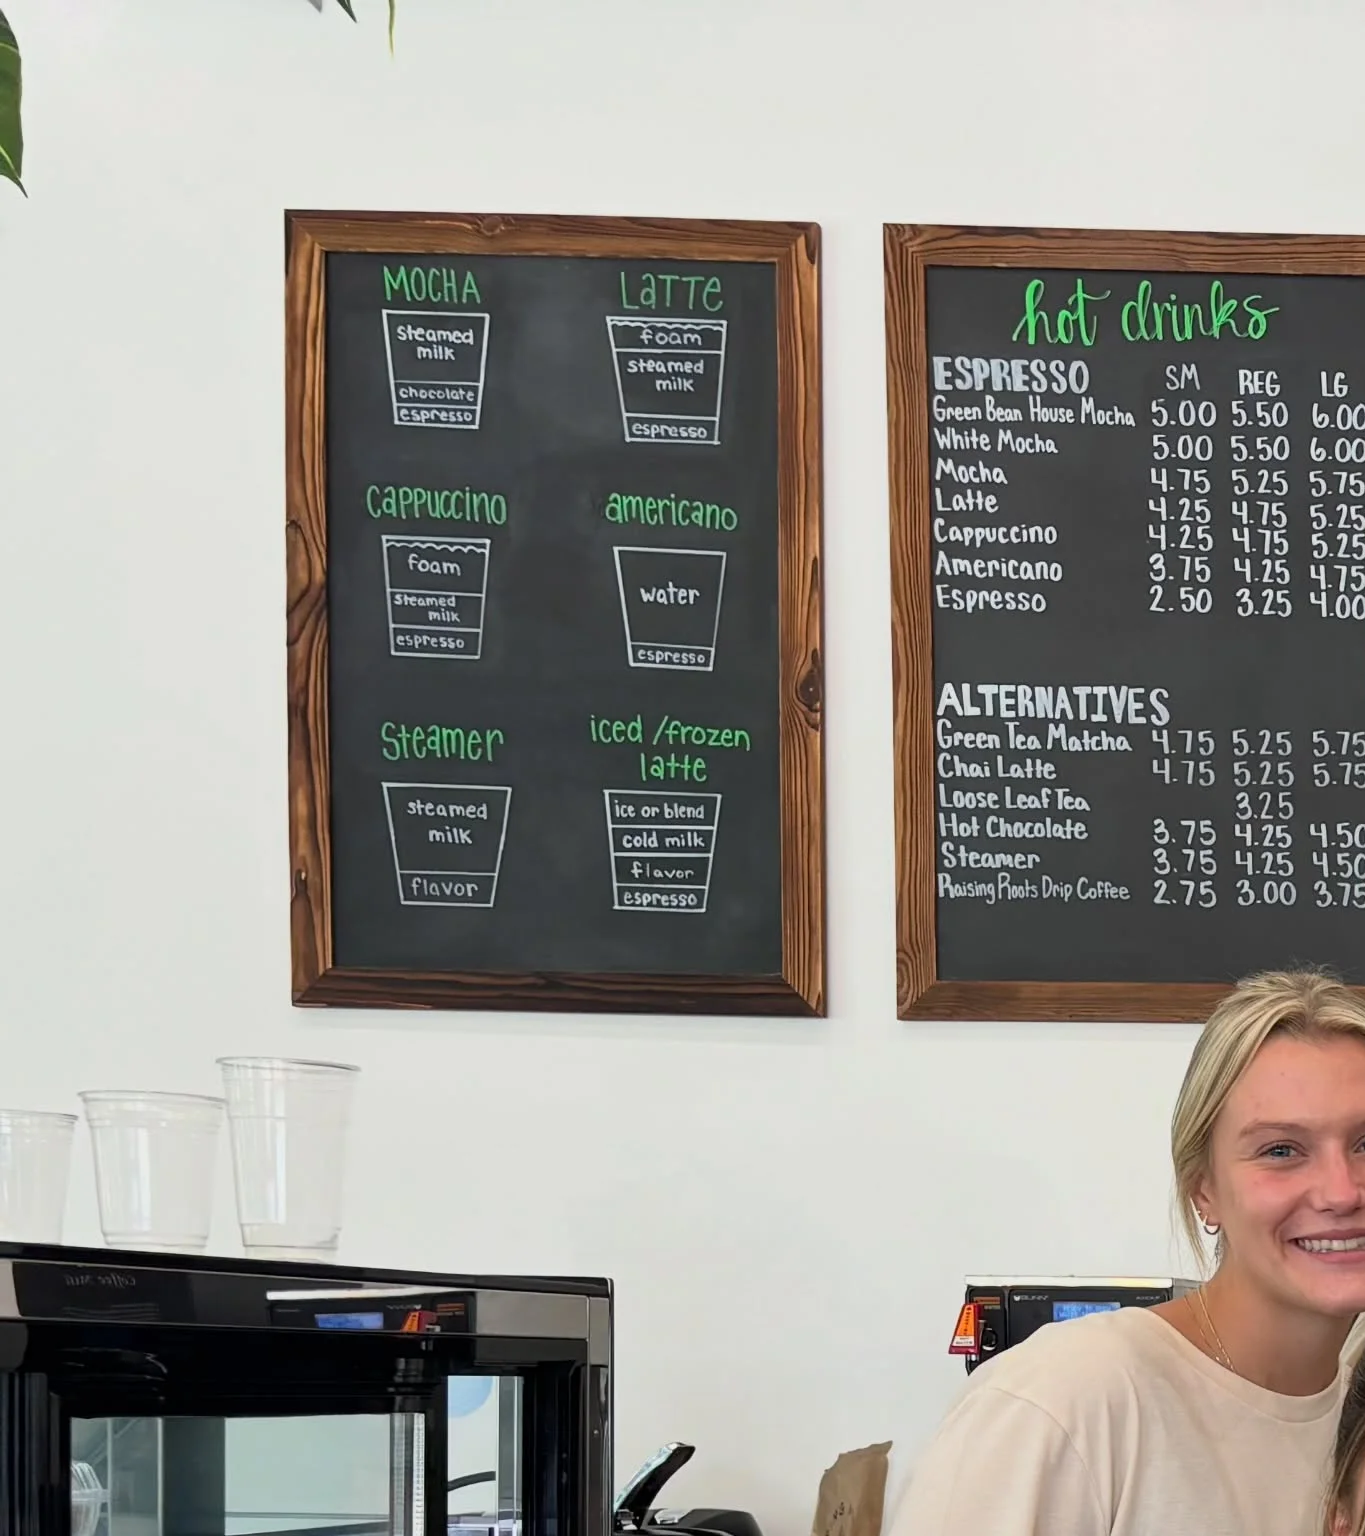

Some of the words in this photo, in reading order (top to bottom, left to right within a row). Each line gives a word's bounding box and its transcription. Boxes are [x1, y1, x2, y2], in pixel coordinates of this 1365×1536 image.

[383, 265, 481, 304] MOCHA
[1011, 278, 1111, 347] hot
[1121, 280, 1280, 342] drinks
[396, 324, 474, 346] steamed
[639, 328, 702, 346] foam
[416, 344, 456, 361] milk
[626, 358, 704, 375] steamed
[932, 355, 1090, 395] ESPRESSO
[1165, 363, 1201, 391] SM
[1238, 368, 1281, 397] REG
[1320, 370, 1349, 398] LG
[398, 386, 475, 402] chocolate
[655, 376, 695, 392] milk
[399, 408, 473, 422] espresso
[932, 394, 983, 423] Green
[984, 394, 1023, 423] Bean
[1028, 394, 1076, 424] House
[1080, 396, 1136, 427] Mocha
[1151, 398, 1217, 427] 5.00
[1231, 400, 1289, 428] 5.50
[631, 422, 708, 439] espresso
[605, 492, 738, 531] americano
[407, 553, 461, 577] foam
[639, 581, 700, 605] water
[637, 649, 706, 665] espresso
[936, 682, 1170, 727] ALTERNATIVES
[590, 714, 643, 743] iced
[381, 722, 504, 762] Steamer
[640, 752, 707, 782] latte
[614, 799, 636, 818] ice
[640, 805, 660, 818] or
[663, 802, 705, 820] blend
[938, 783, 1000, 809] Loose
[1004, 786, 1052, 810] Leaf
[1054, 788, 1091, 812] Tea
[1235, 791, 1294, 821] 3.25
[622, 830, 659, 849] cold
[664, 831, 705, 848] milk
[411, 877, 479, 897] flavor
[937, 872, 996, 905] Raising
[997, 871, 1039, 900] Roots
[1041, 875, 1073, 902] Drip
[1076, 876, 1131, 900] Coffee
[1153, 879, 1217, 908] 2.75
[1235, 879, 1297, 906] 3.00
